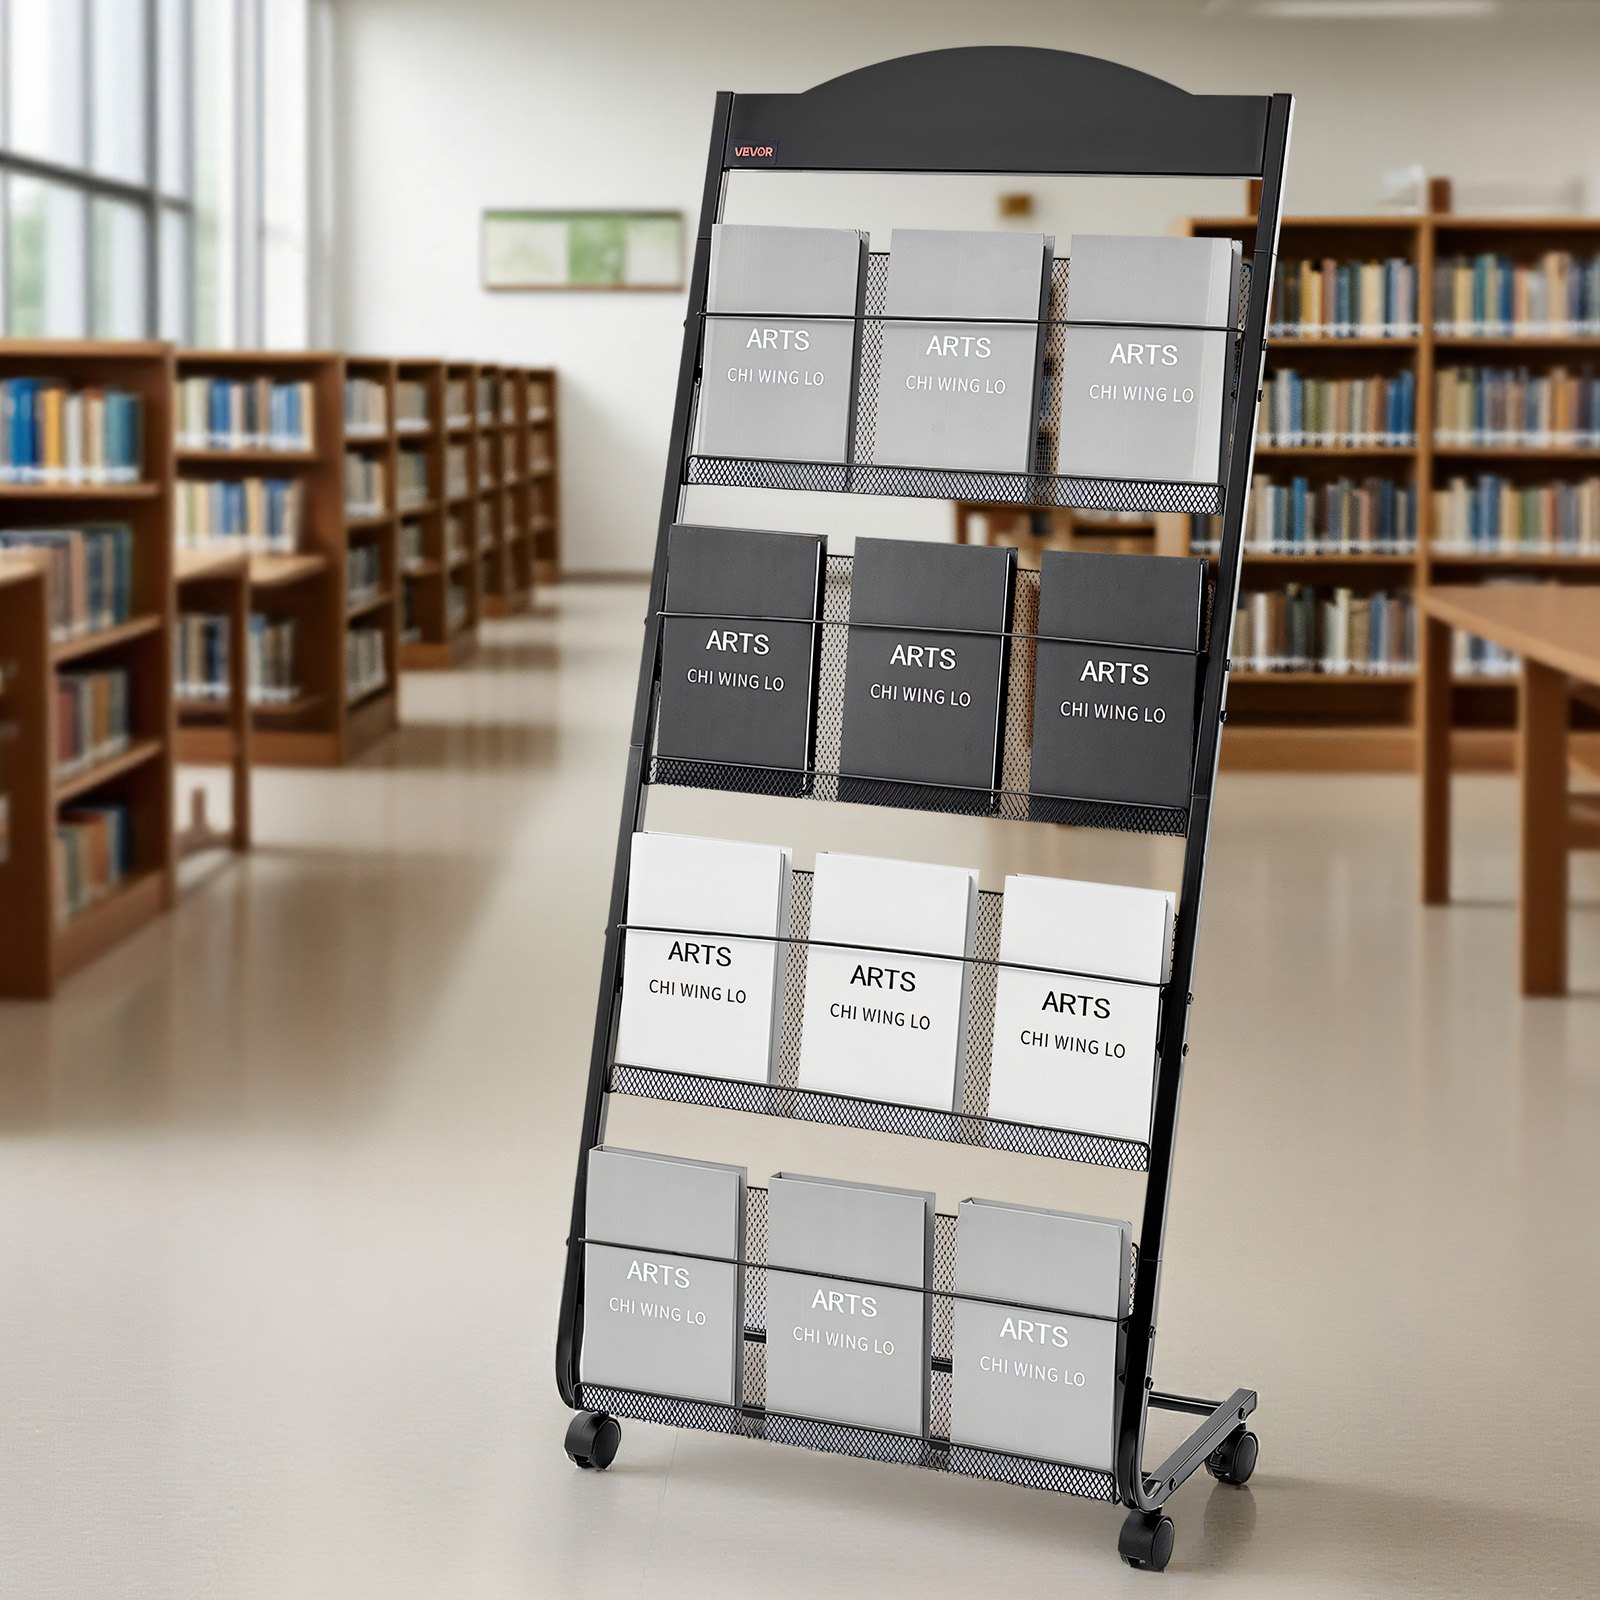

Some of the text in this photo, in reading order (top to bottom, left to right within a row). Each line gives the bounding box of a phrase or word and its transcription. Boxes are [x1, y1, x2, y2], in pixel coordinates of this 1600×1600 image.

[735, 146, 774, 157] VEVOR
[745, 328, 810, 351] ARTS
[925, 334, 992, 358] ARTS
[1109, 342, 1178, 366] ARTS
[727, 367, 824, 386] CHI WING LO
[906, 375, 1006, 395] CHI WING LO
[1089, 384, 1194, 403] CHI WING LO
[705, 629, 770, 655] ARTS
[889, 644, 956, 670] ARTS
[687, 668, 784, 692] CHI WING LO
[1079, 660, 1149, 685] ARTS
[870, 683, 971, 707] CHI WING LO
[1060, 701, 1166, 724] CHI WING LO
[667, 940, 732, 967] ARTS
[649, 979, 747, 1004] CHI WING LO
[849, 964, 916, 993] ARTS
[830, 1003, 931, 1031] CHI WING LO
[1041, 990, 1111, 1019] ARTS
[1020, 1030, 1126, 1059] CHI WING LO
[626, 1260, 690, 1289] ARTS
[609, 1297, 707, 1326] CHI WING LO
[811, 1288, 878, 1318] ARTS
[792, 1326, 895, 1356] CHI WING LO
[999, 1317, 1069, 1348] ARTS
[980, 1355, 1086, 1387] CHI WING LO
